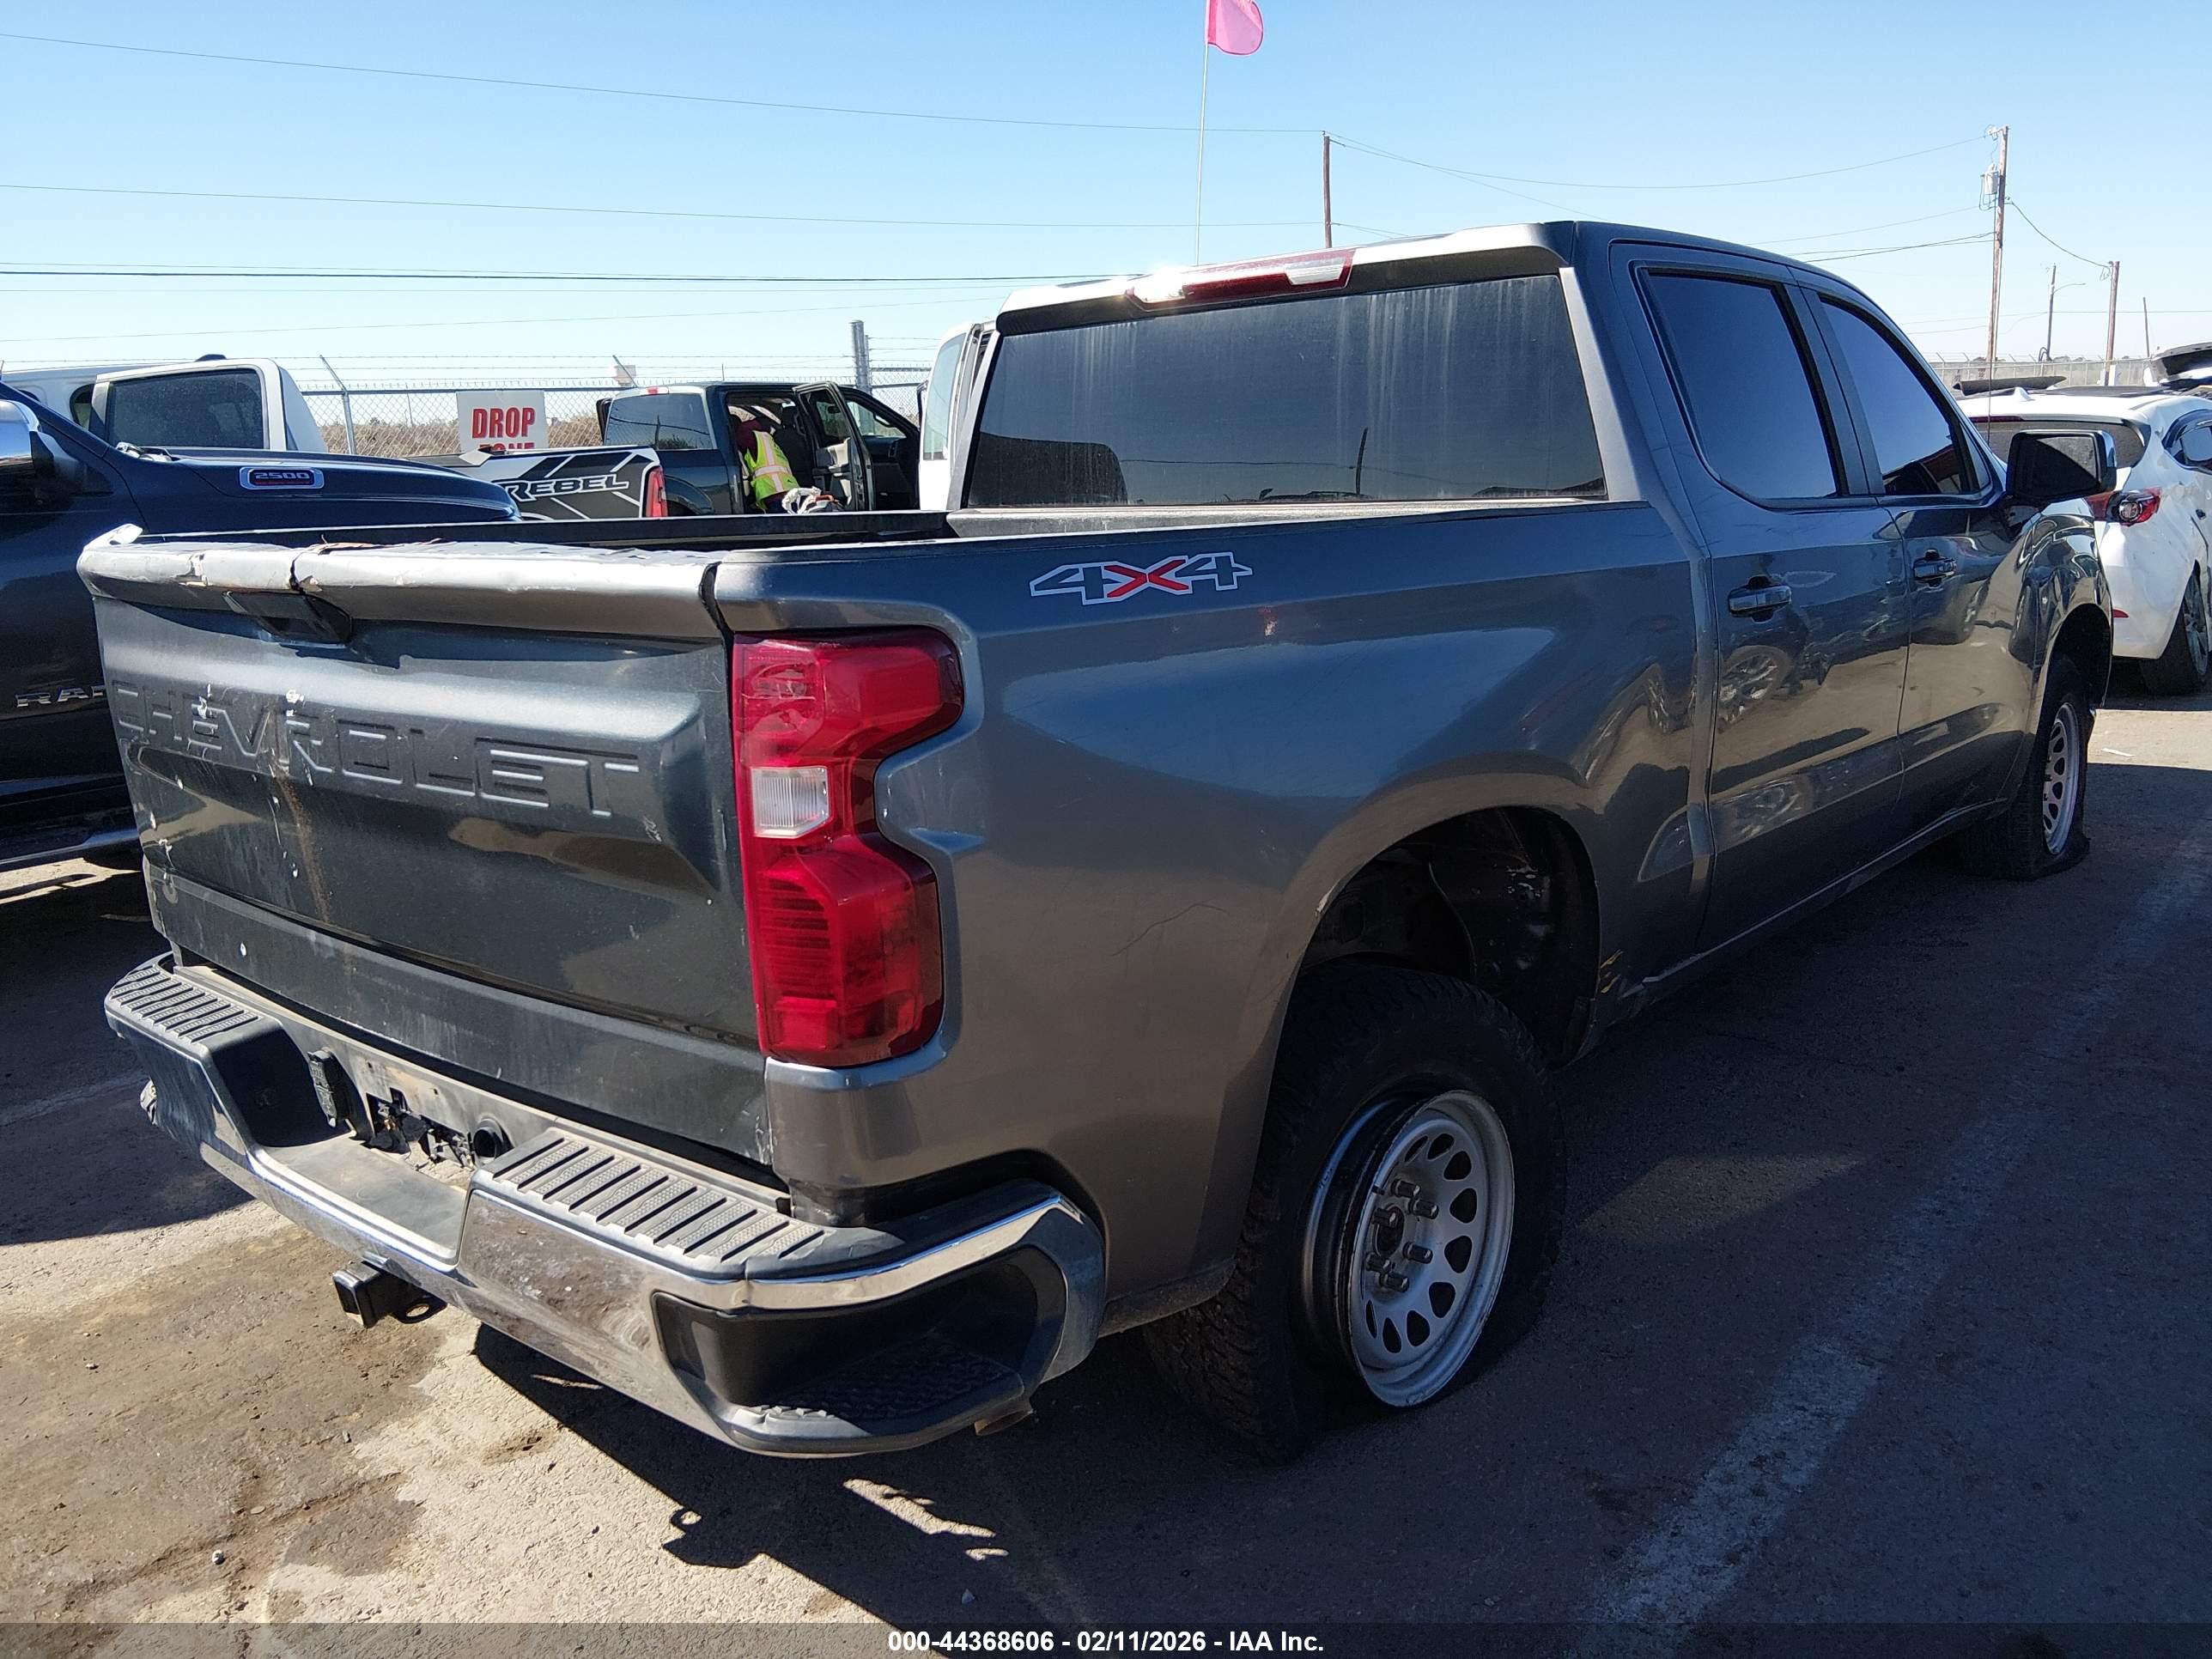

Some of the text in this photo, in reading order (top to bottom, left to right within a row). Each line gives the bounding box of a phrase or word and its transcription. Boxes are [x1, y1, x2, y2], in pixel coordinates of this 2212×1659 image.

[471, 407, 536, 439] DROP
[503, 473, 629, 502] REBEL
[112, 679, 639, 817] CHEVROLET
